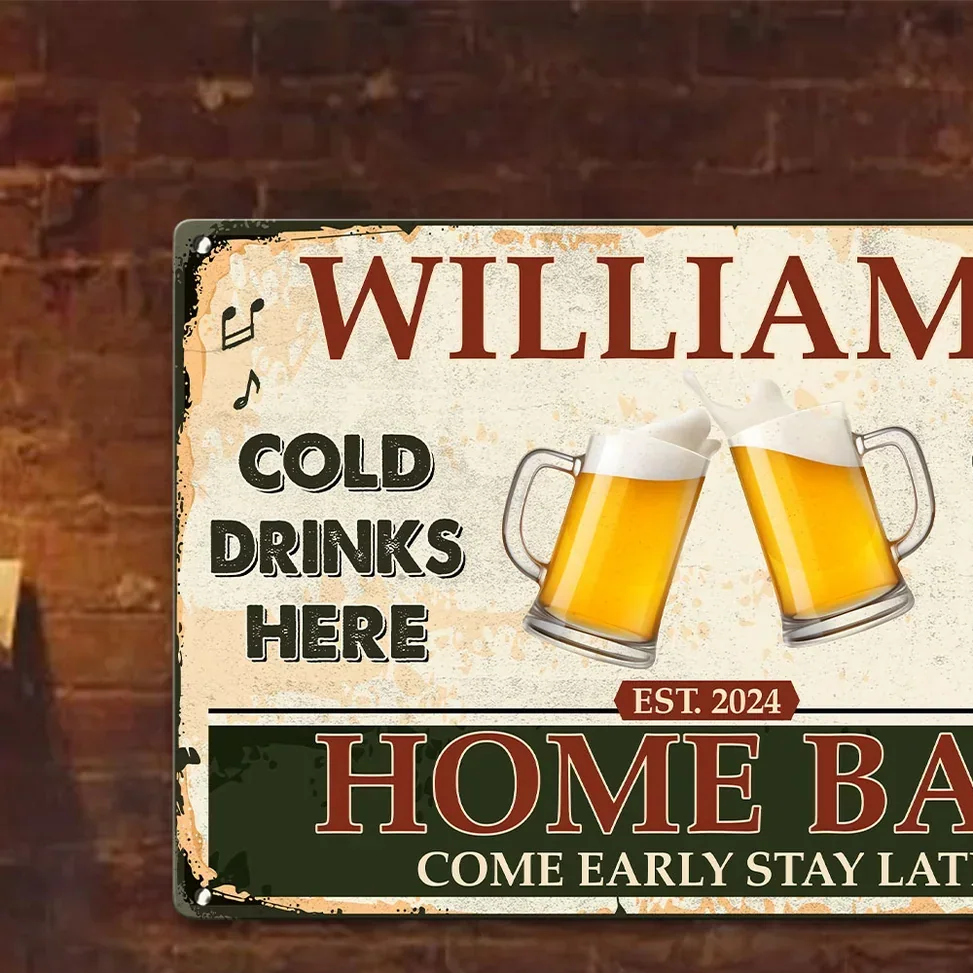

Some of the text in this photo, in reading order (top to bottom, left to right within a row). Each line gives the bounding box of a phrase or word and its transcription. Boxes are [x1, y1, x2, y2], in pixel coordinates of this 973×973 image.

[238, 432, 435, 493] COLD
[210, 518, 466, 579] DRINKS
[246, 604, 430, 663] HERE
[632, 687, 782, 716] EST. 2024
[314, 730, 762, 836] HOME
[416, 850, 564, 887] COME
[577, 851, 735, 887] EARLY
[745, 850, 865, 887] STAY
